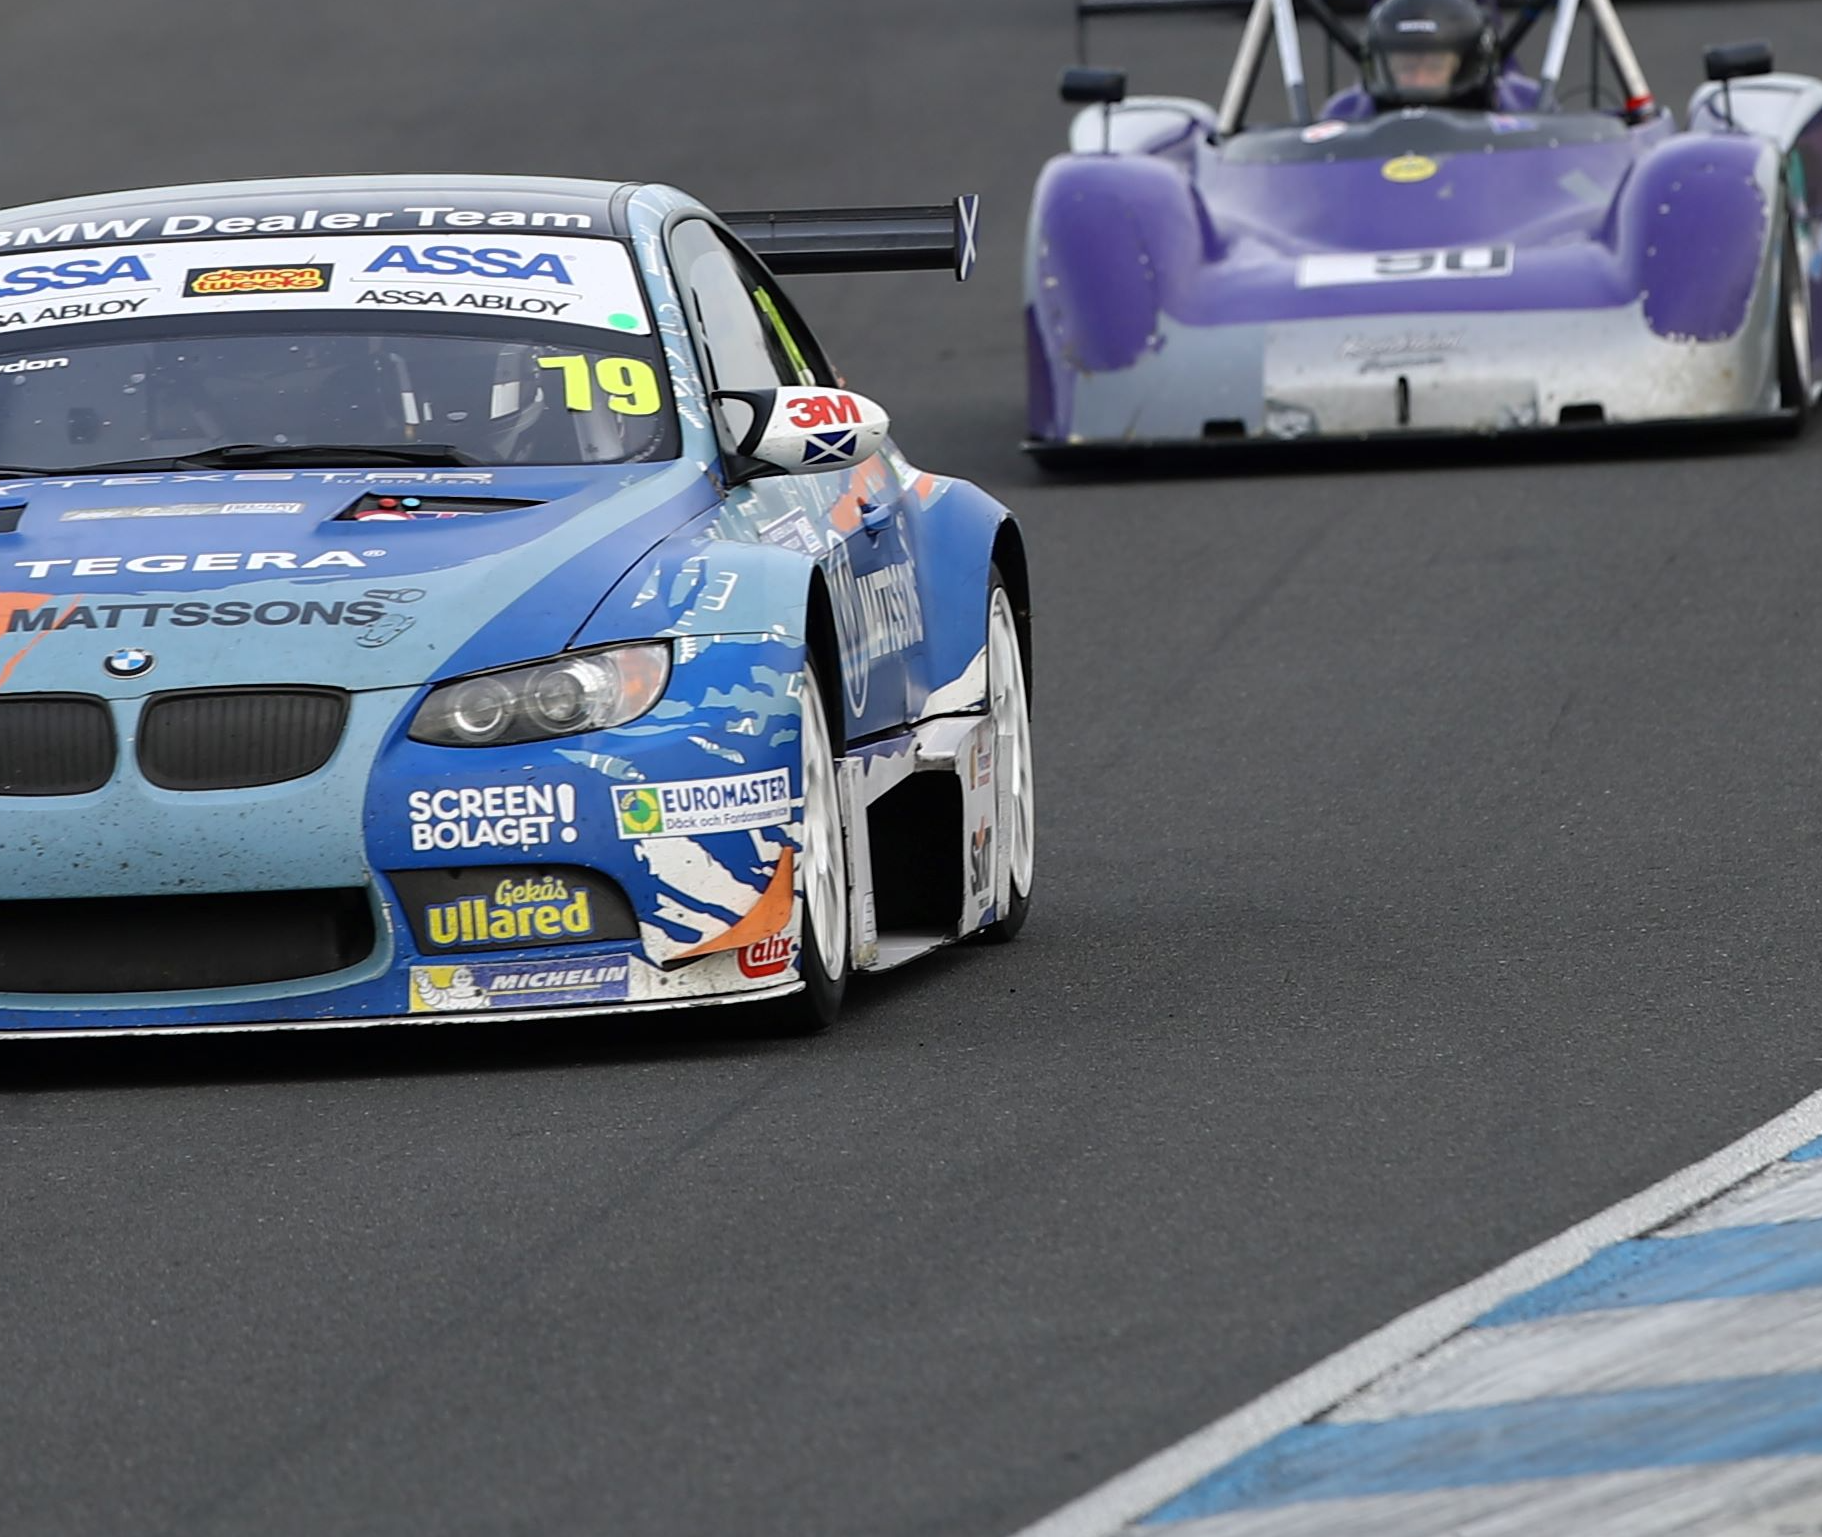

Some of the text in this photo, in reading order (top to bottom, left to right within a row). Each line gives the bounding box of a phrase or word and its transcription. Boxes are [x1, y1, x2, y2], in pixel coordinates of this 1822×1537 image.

[161, 209, 394, 237] Dealer
[404, 207, 592, 229] Team
[201, 270, 318, 281] demon
[362, 245, 574, 285] ASSA
[196, 278, 319, 291] tweeks
[33, 297, 149, 323] ABLOY
[356, 290, 571, 316] ASSA ABLOY
[537, 355, 661, 416] 19
[785, 395, 862, 428] 3M
[14, 550, 368, 579] TEGERA
[6, 600, 388, 633] MATTSSONS
[661, 775, 788, 813] EUROMASTER
[495, 876, 569, 907] Gekås
[427, 889, 591, 945] Ullared
[489, 964, 629, 991] MICHELIN
